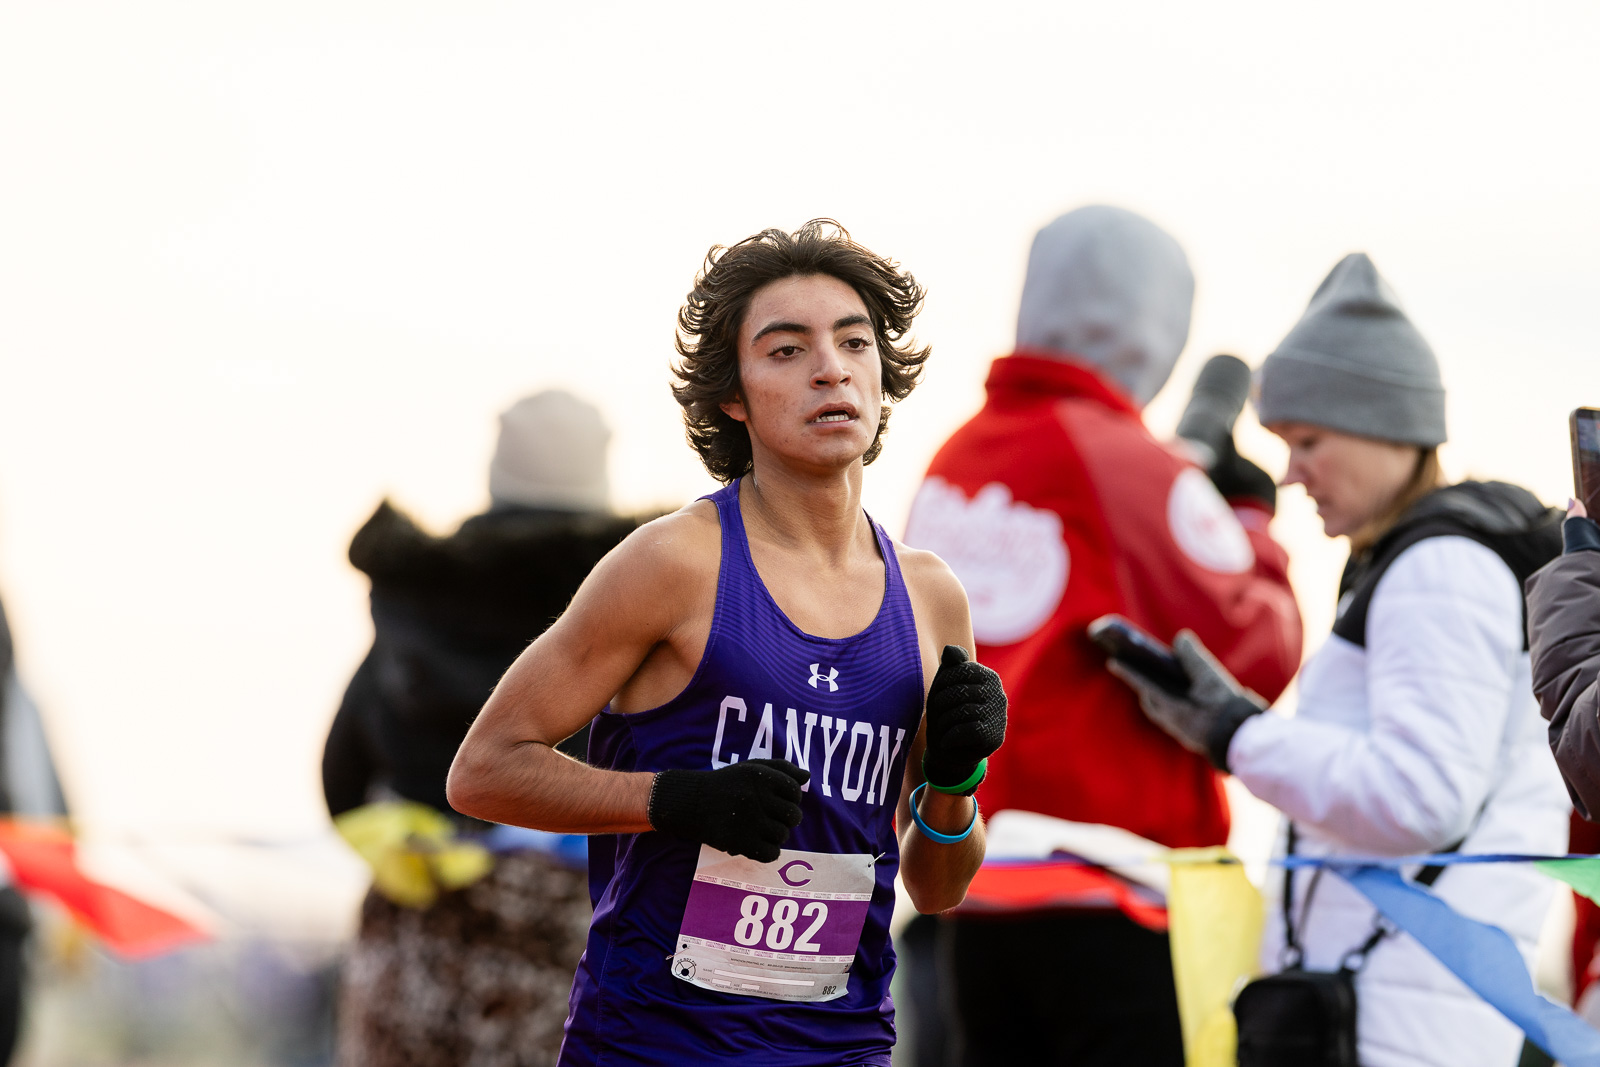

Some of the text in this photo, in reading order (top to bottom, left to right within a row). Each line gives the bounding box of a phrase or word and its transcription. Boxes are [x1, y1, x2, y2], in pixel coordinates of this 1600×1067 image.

[711, 695, 906, 806] CANYON
[777, 859, 814, 887] C
[733, 894, 829, 953] 882
[822, 985, 837, 995] 882
